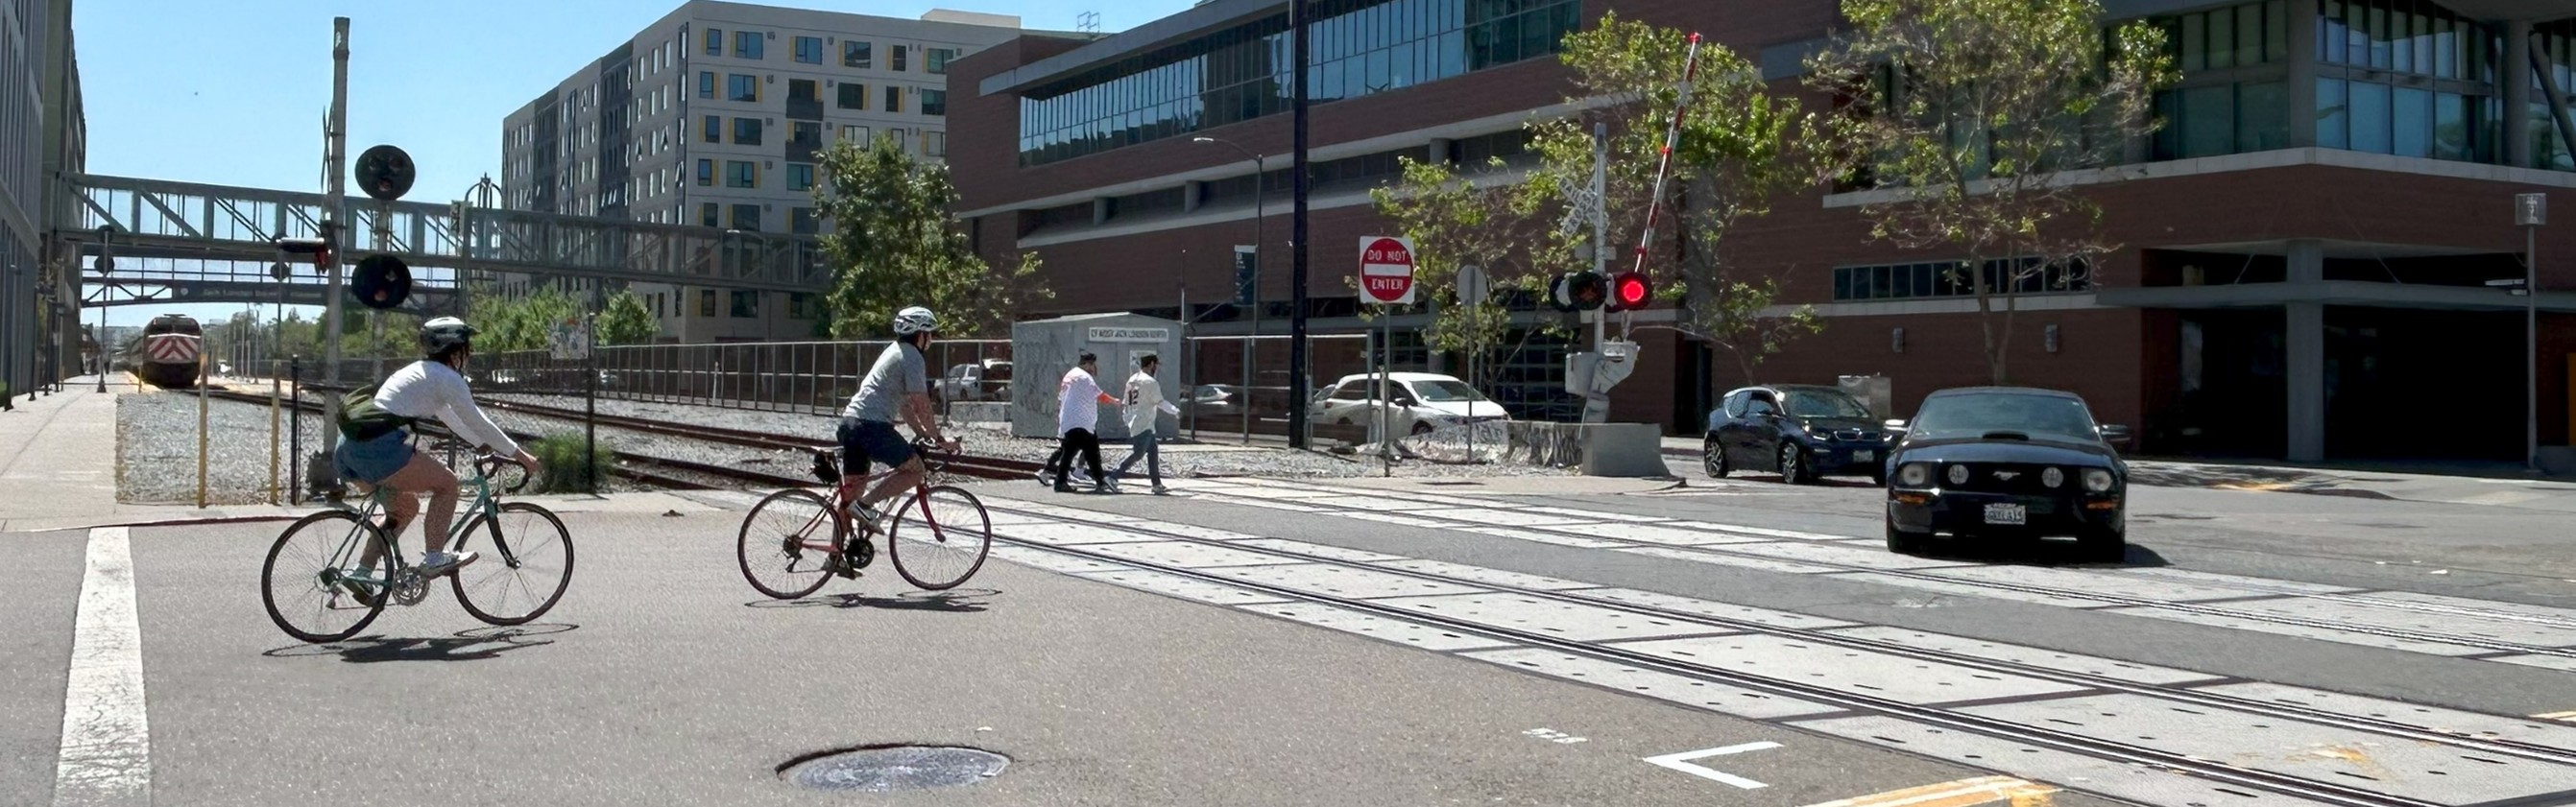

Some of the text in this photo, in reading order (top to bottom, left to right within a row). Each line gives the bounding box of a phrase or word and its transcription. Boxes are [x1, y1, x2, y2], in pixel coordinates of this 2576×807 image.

[1367, 249, 1407, 261] DO NOT
[1372, 278, 1404, 290] ENTER
[1128, 390, 1139, 405] 12
